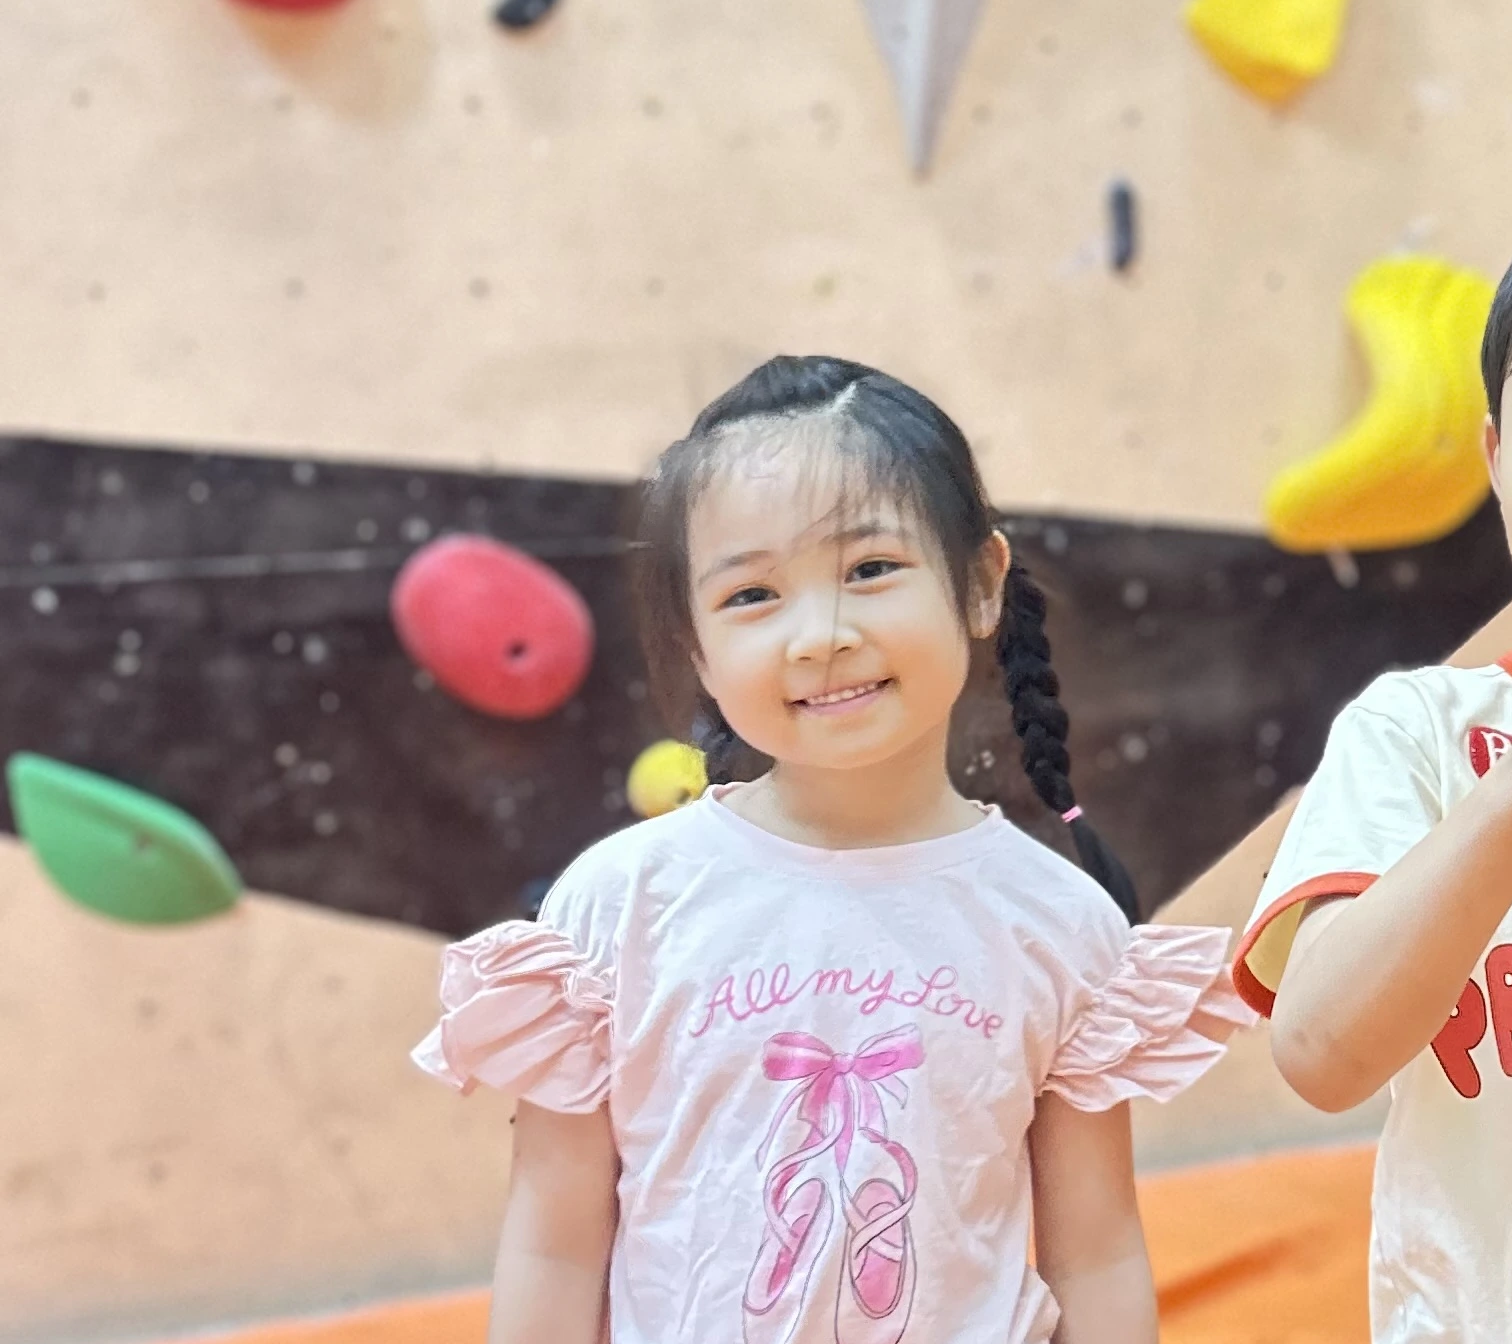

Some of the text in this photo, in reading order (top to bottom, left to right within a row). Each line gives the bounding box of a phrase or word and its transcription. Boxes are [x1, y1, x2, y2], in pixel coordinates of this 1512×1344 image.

[688, 962, 1005, 1040] All my Love
